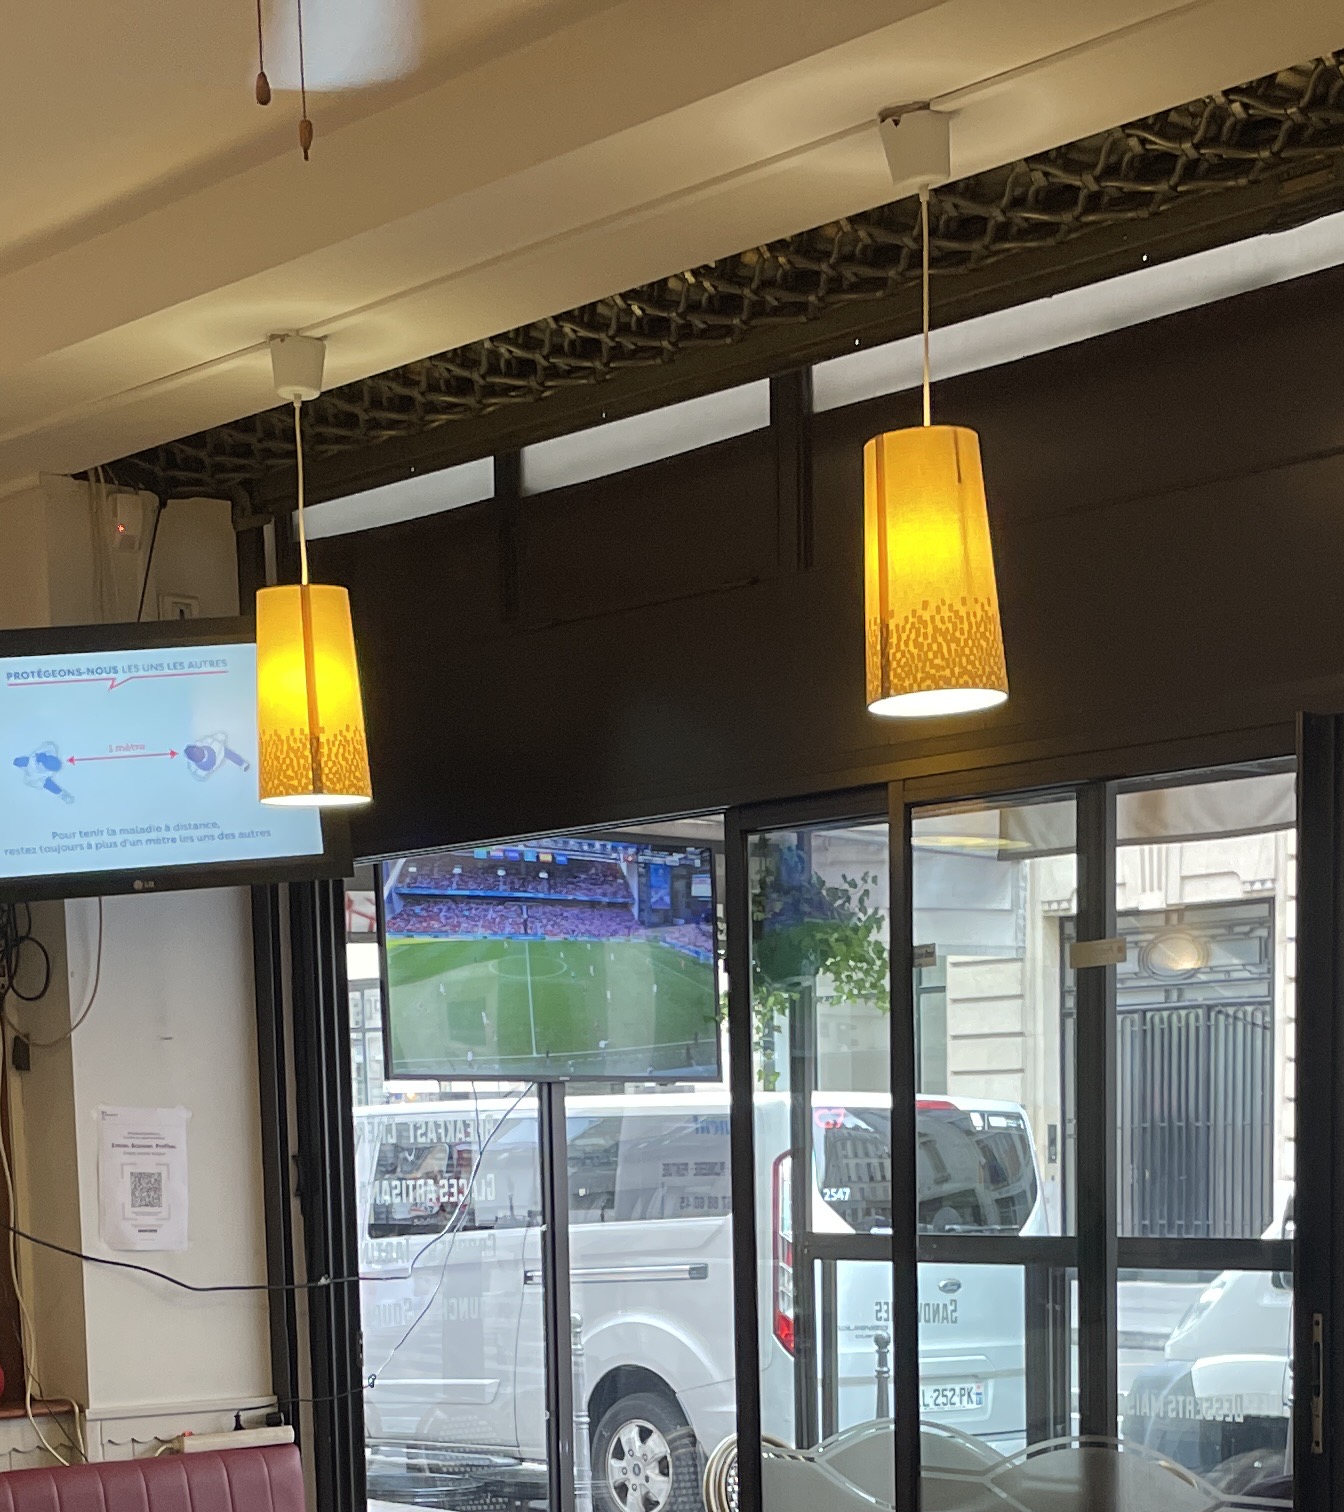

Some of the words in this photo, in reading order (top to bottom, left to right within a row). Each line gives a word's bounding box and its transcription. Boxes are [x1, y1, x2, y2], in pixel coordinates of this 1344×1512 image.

[6, 666, 119, 680] PROTÉGEONS-NOUS
[121, 663, 139, 674] LES
[142, 662, 165, 672] UNS
[167, 661, 185, 671] LES
[187, 658, 228, 669] AUTRES
[79, 828, 104, 838] tenir
[106, 827, 117, 836] la
[119, 825, 163, 835] maladie
[39, 842, 85, 854] toujours
